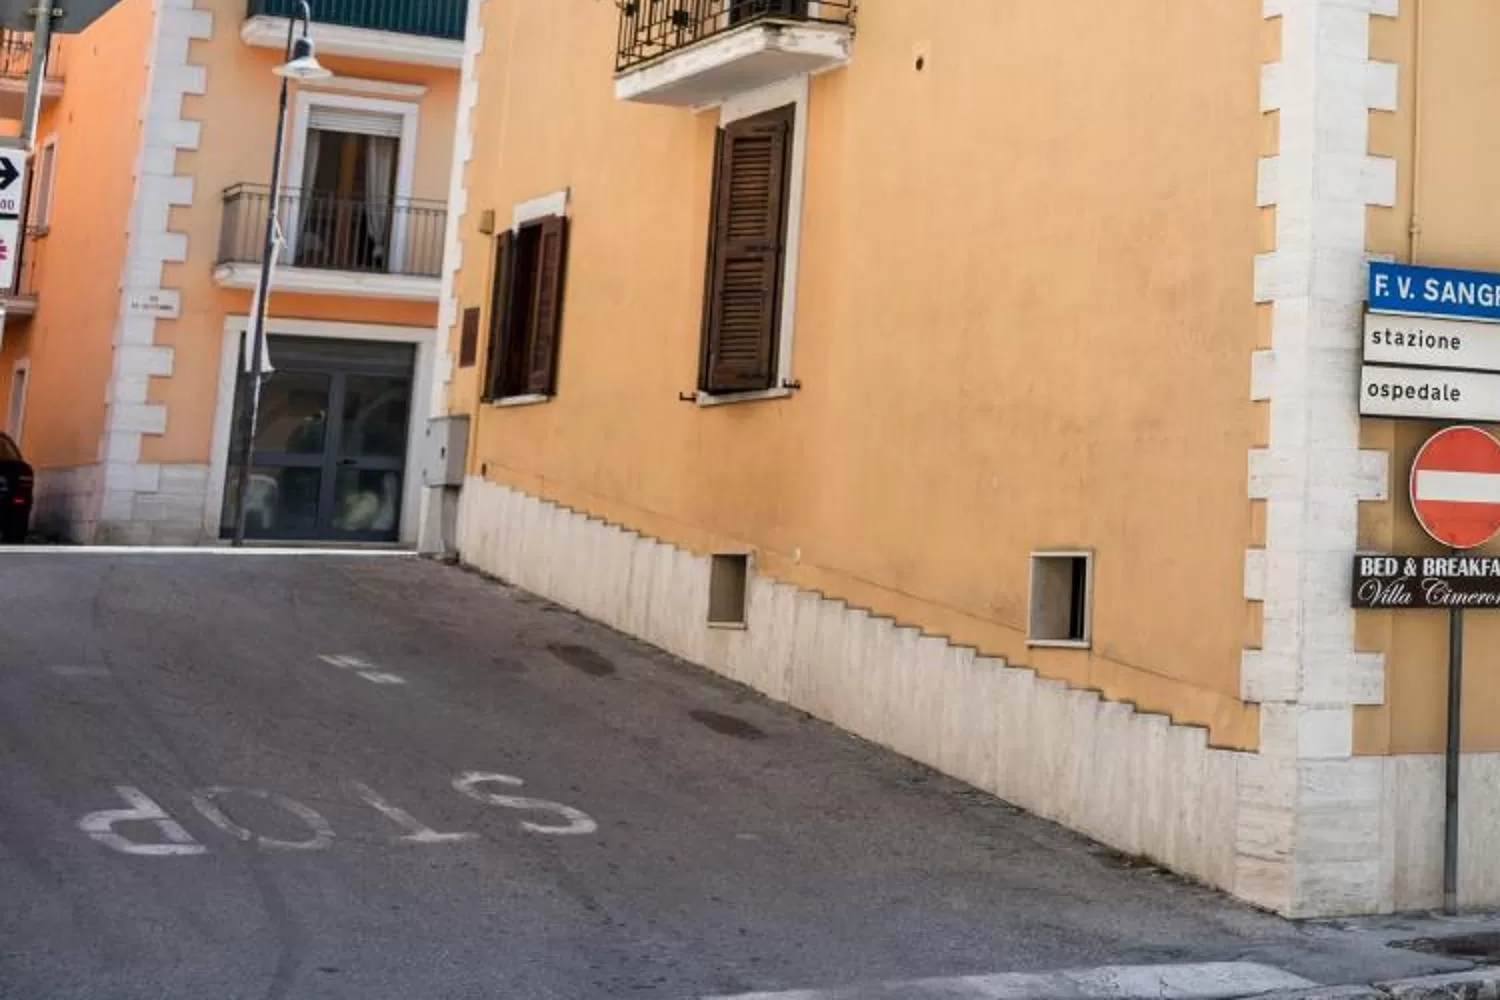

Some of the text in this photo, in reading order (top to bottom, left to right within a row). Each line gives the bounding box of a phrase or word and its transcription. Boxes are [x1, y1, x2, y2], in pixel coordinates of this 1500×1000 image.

[1375, 273, 1389, 297] F.
[1397, 276, 1414, 299] V.
[1371, 328, 1461, 350] stazione
[1367, 382, 1461, 402] ospedale
[1361, 557, 1398, 576] BED
[1403, 558, 1417, 577] &
[1357, 576, 1412, 605] Villa
[78, 770, 598, 855] STOP
